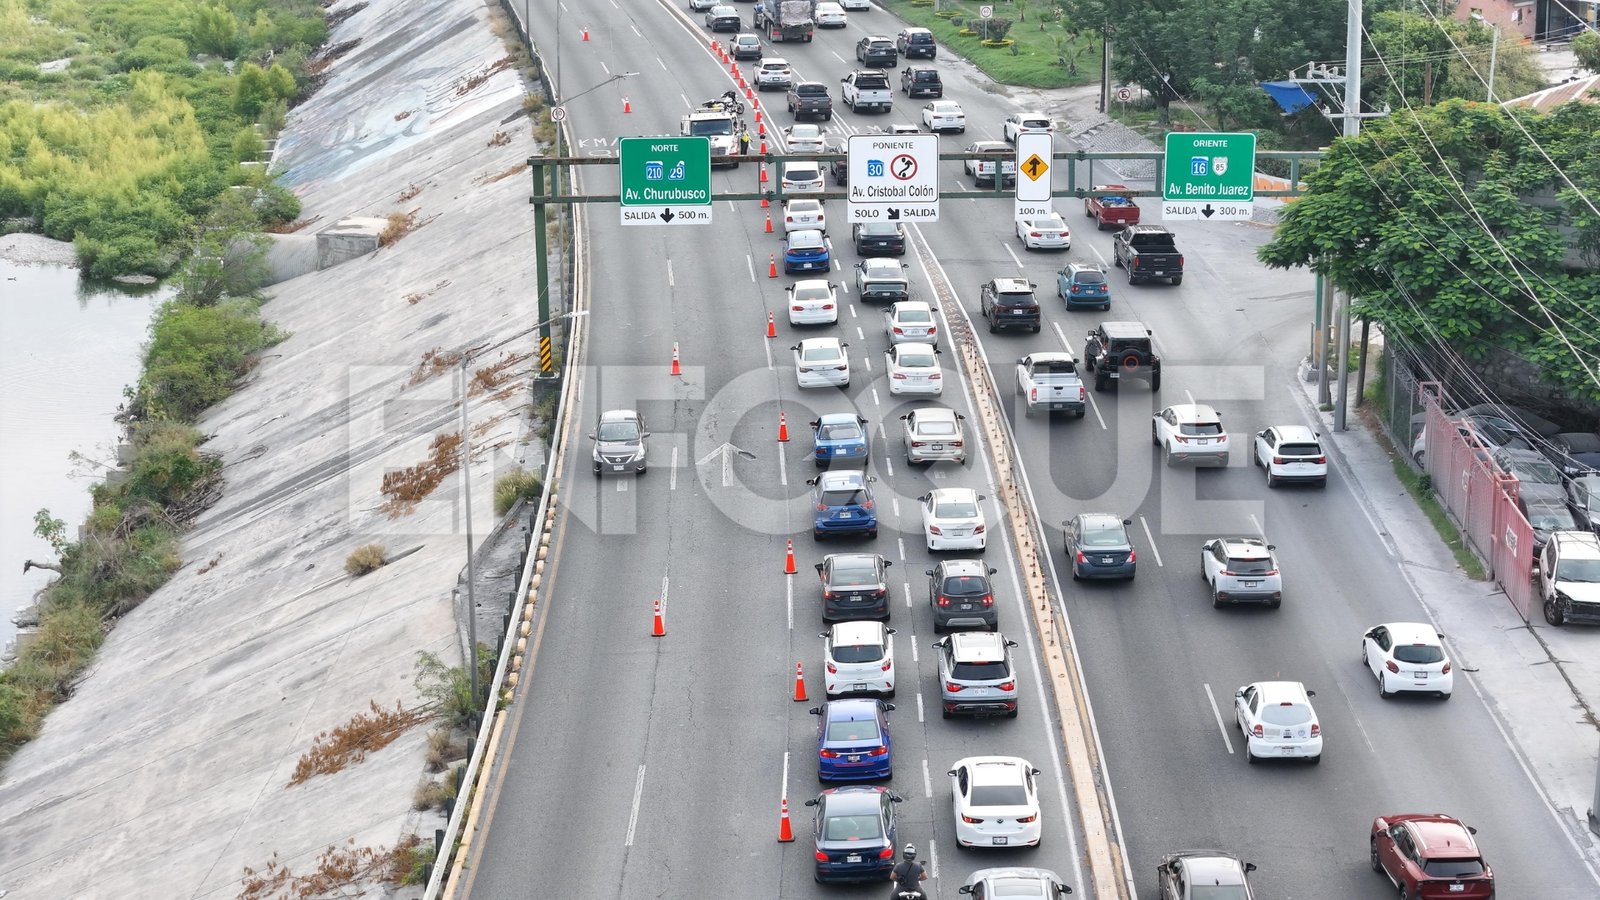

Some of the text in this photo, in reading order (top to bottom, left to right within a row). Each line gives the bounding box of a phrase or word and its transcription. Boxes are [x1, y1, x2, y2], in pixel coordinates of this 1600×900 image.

[651, 144, 679, 152] NORTE
[647, 167, 662, 179] 210
[669, 167, 683, 179] 29
[869, 164, 882, 176] 30
[1193, 162, 1206, 174] 16
[1215, 163, 1224, 171] 85
[625, 187, 706, 200] Av. Churubusco
[852, 184, 934, 197] Av. Cristobal Colón
[1169, 182, 1248, 195] Av. Benito Juarez
[624, 211, 656, 220] SALIDA
[678, 211, 696, 219] 500
[854, 208, 936, 217] SOLO SALIDA
[1019, 207, 1035, 215] 100
[1165, 206, 1197, 215] SALIDA
[1219, 207, 1236, 215] 300
